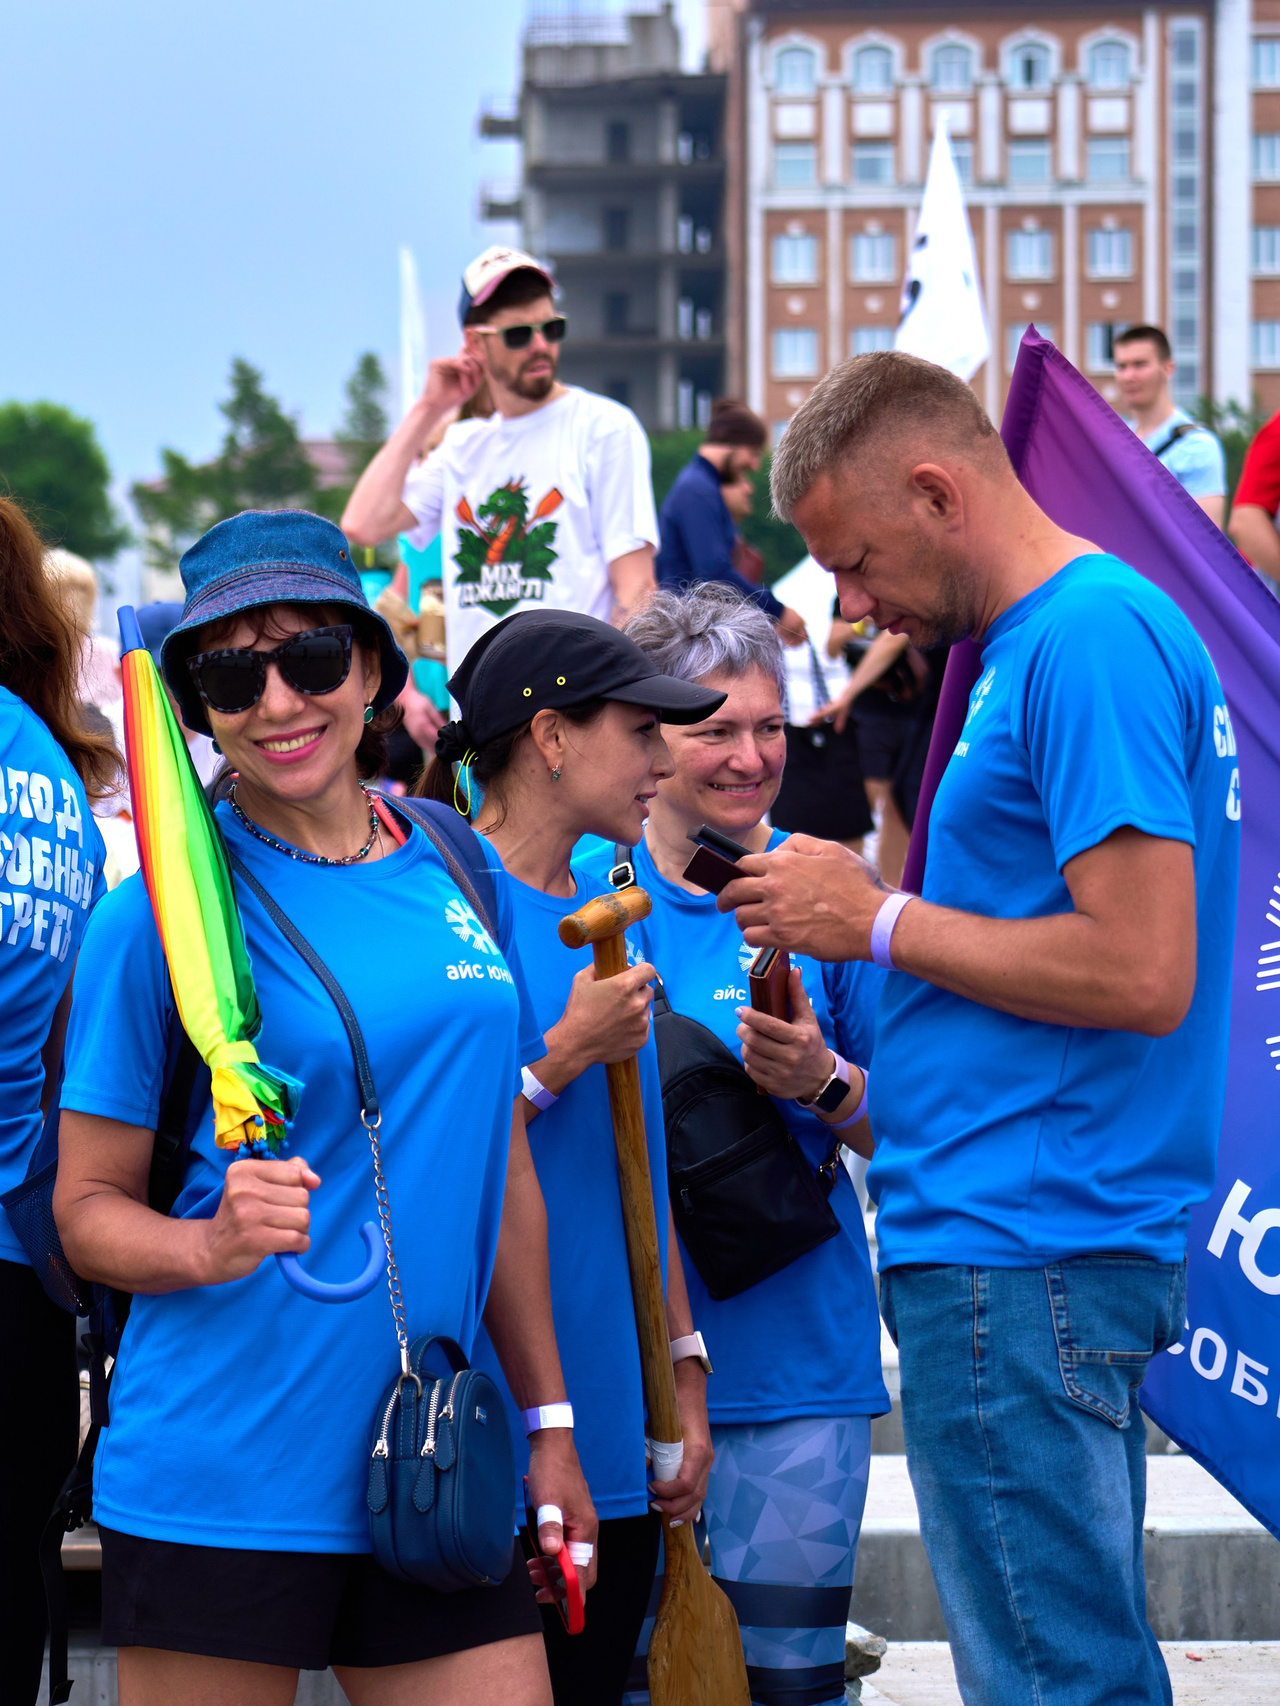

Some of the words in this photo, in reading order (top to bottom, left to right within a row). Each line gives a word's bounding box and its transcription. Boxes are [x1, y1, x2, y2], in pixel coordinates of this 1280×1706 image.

[481, 563, 521, 585] MIX
[445, 960, 484, 980] айс
[713, 985, 747, 1001] айс
